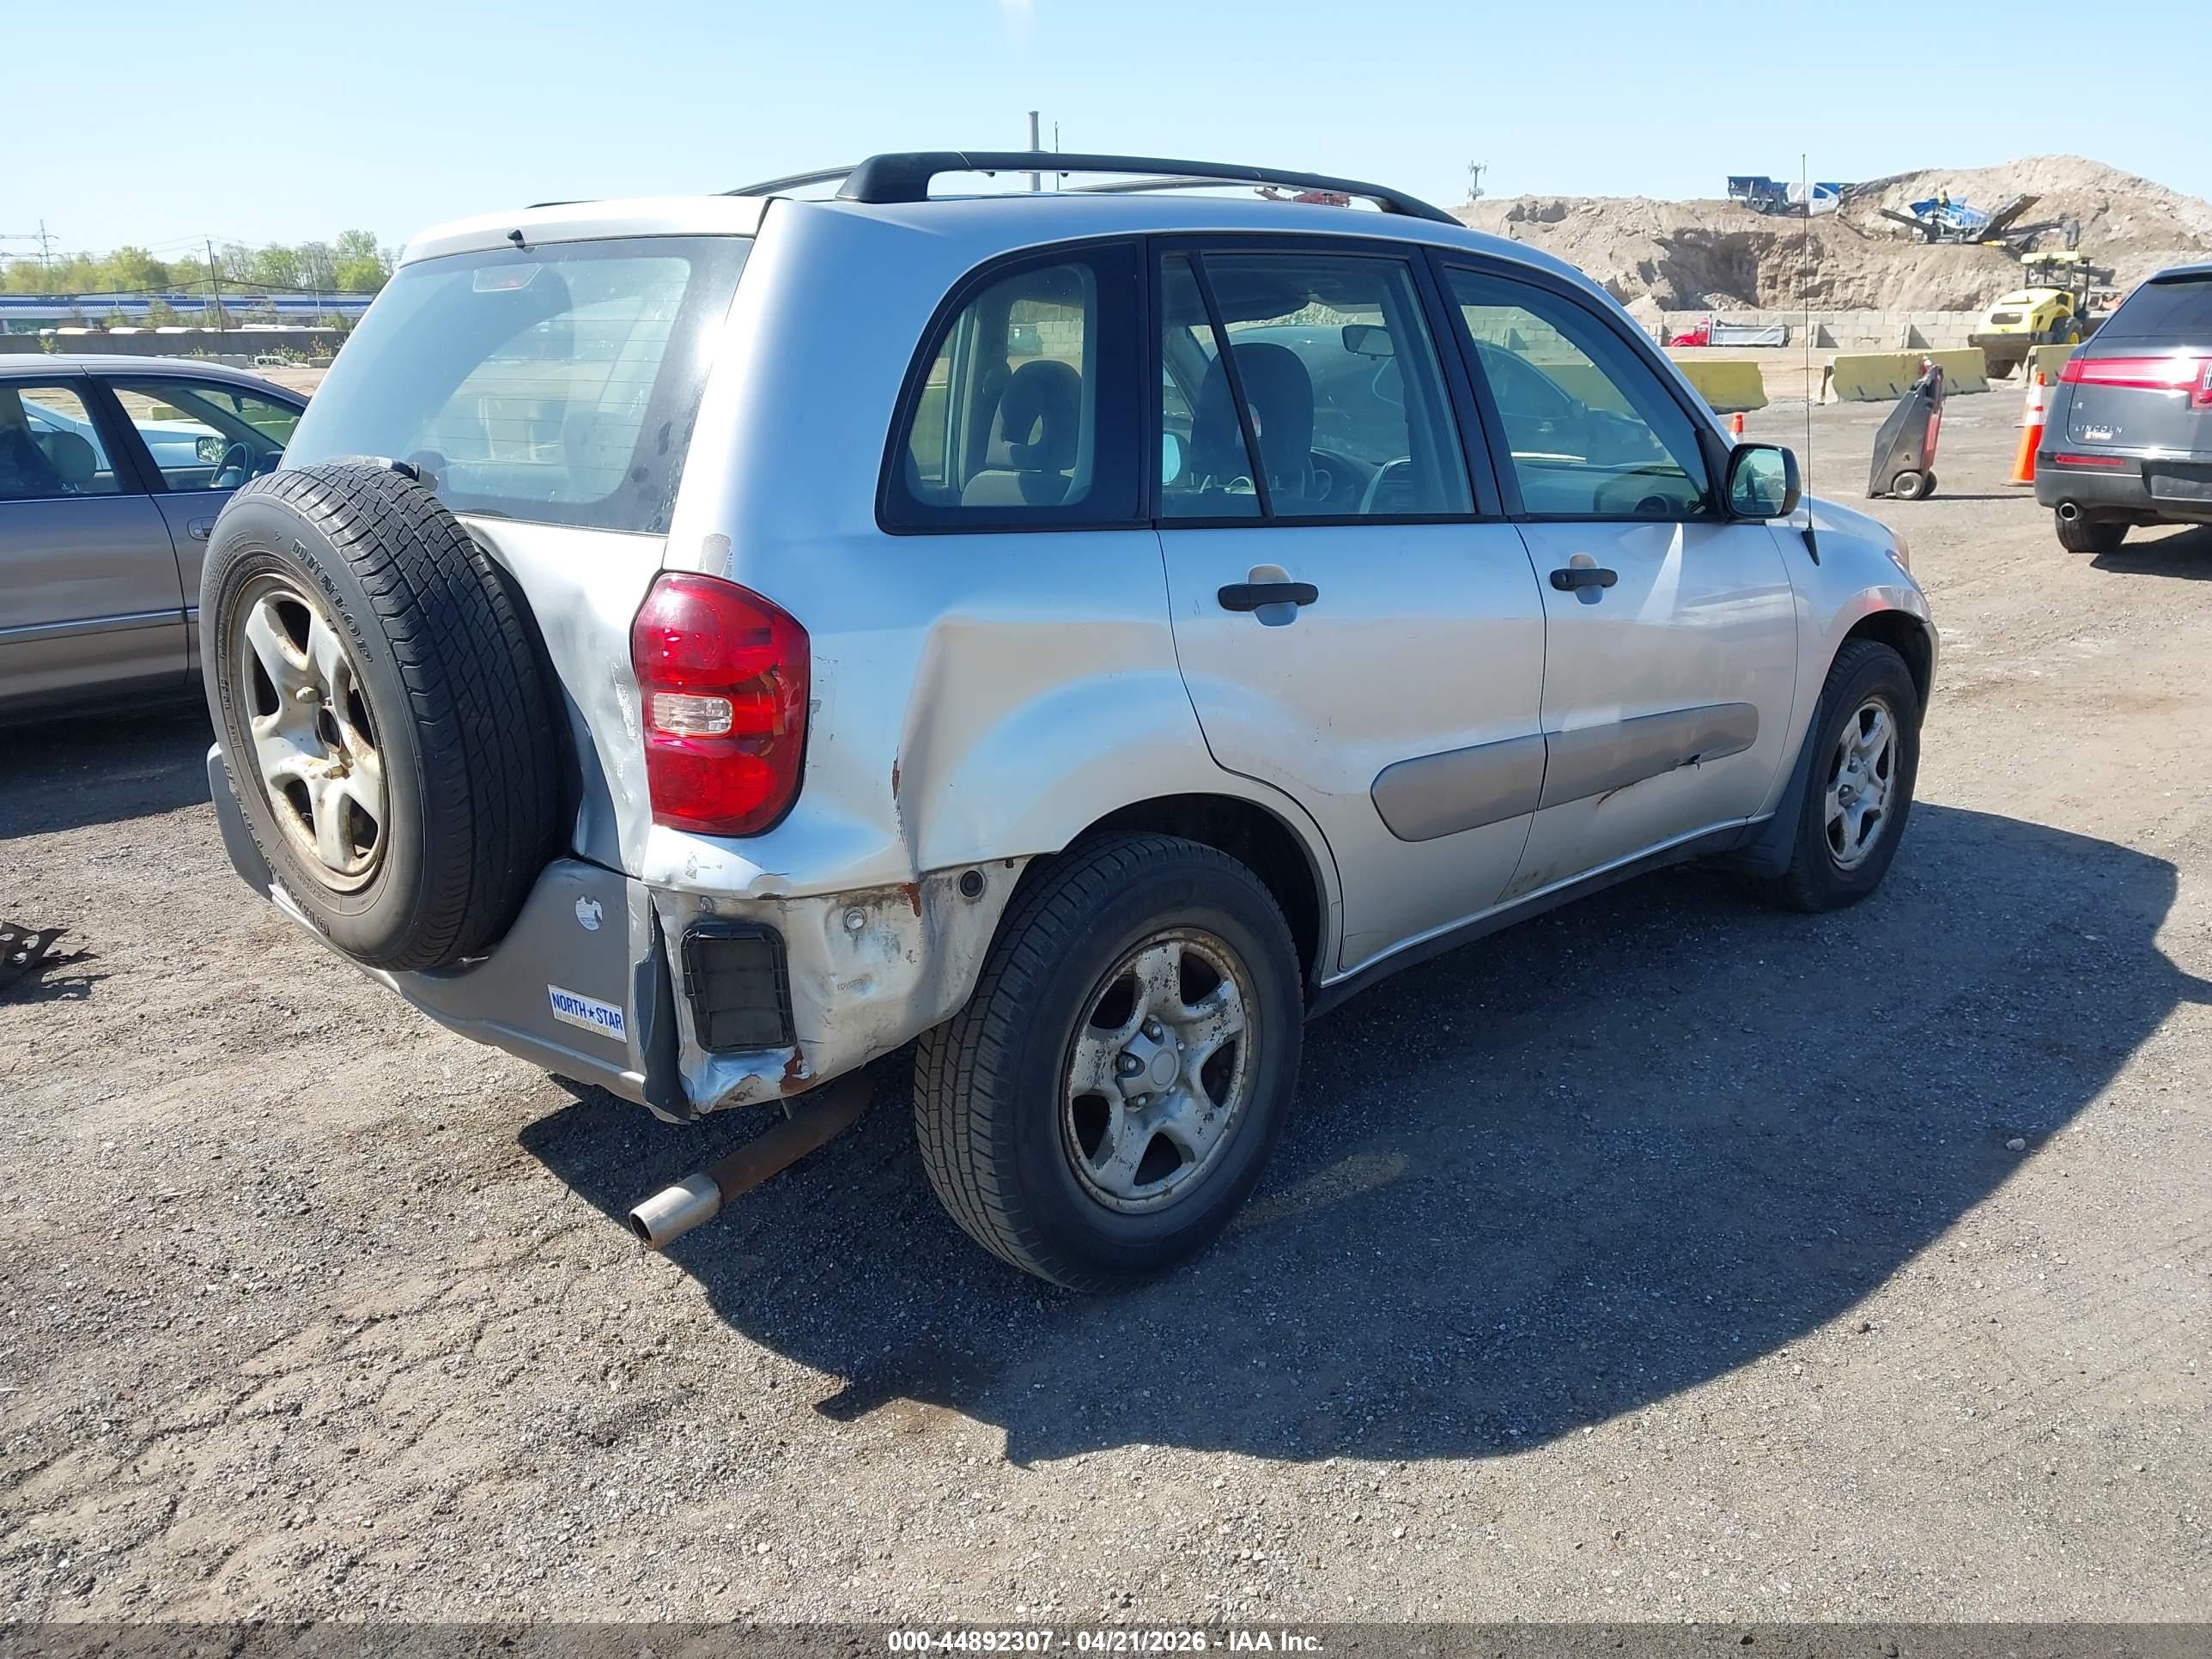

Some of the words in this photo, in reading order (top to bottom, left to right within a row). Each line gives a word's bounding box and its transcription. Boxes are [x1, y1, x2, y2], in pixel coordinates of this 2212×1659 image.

[2075, 424, 2124, 434] LINCOLN
[291, 538, 374, 663] DUNLOP
[551, 992, 587, 1020] NORTH
[596, 1006, 623, 1031] STAR
